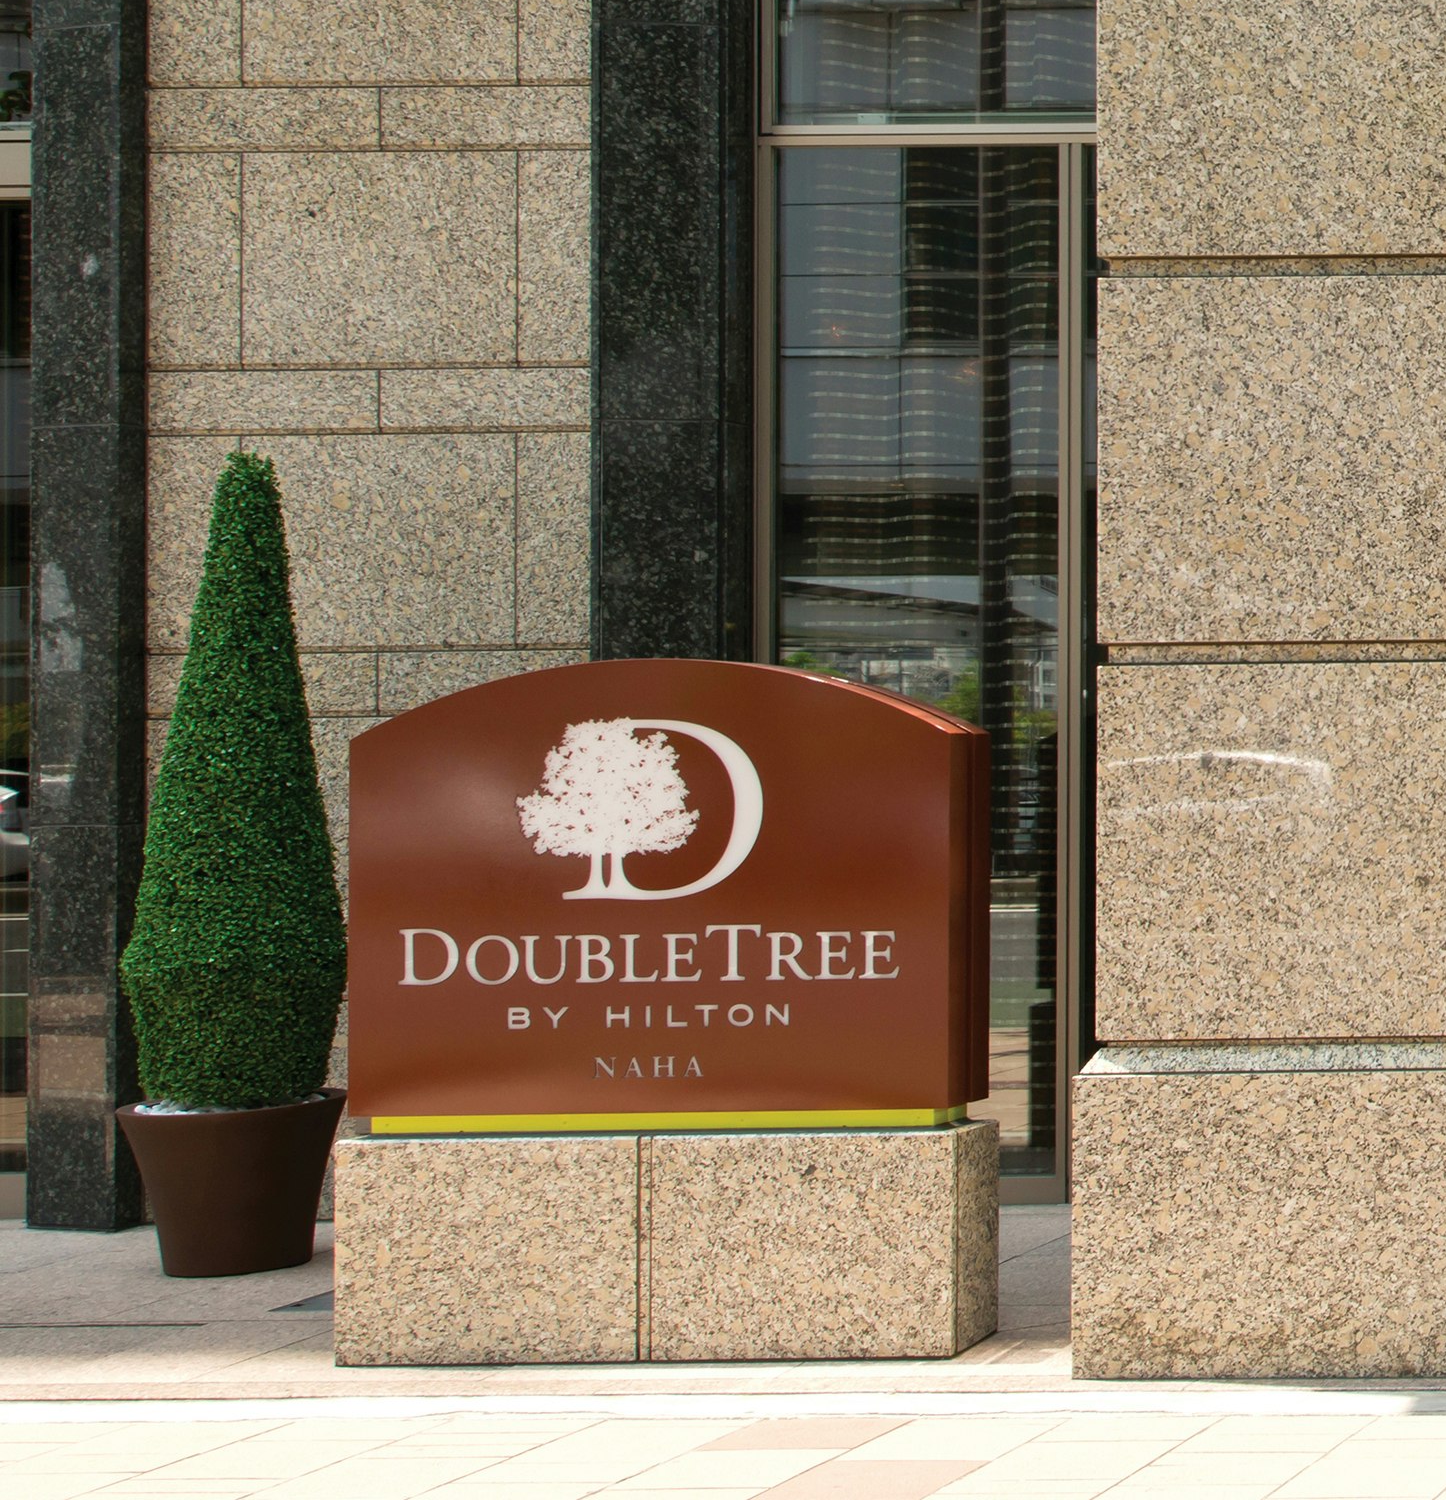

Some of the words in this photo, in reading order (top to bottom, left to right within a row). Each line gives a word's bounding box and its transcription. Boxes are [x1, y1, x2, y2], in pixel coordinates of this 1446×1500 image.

[507, 1006, 568, 1030] BY
[606, 1003, 791, 1029] HILTON
[594, 1055, 705, 1079] NAHA
